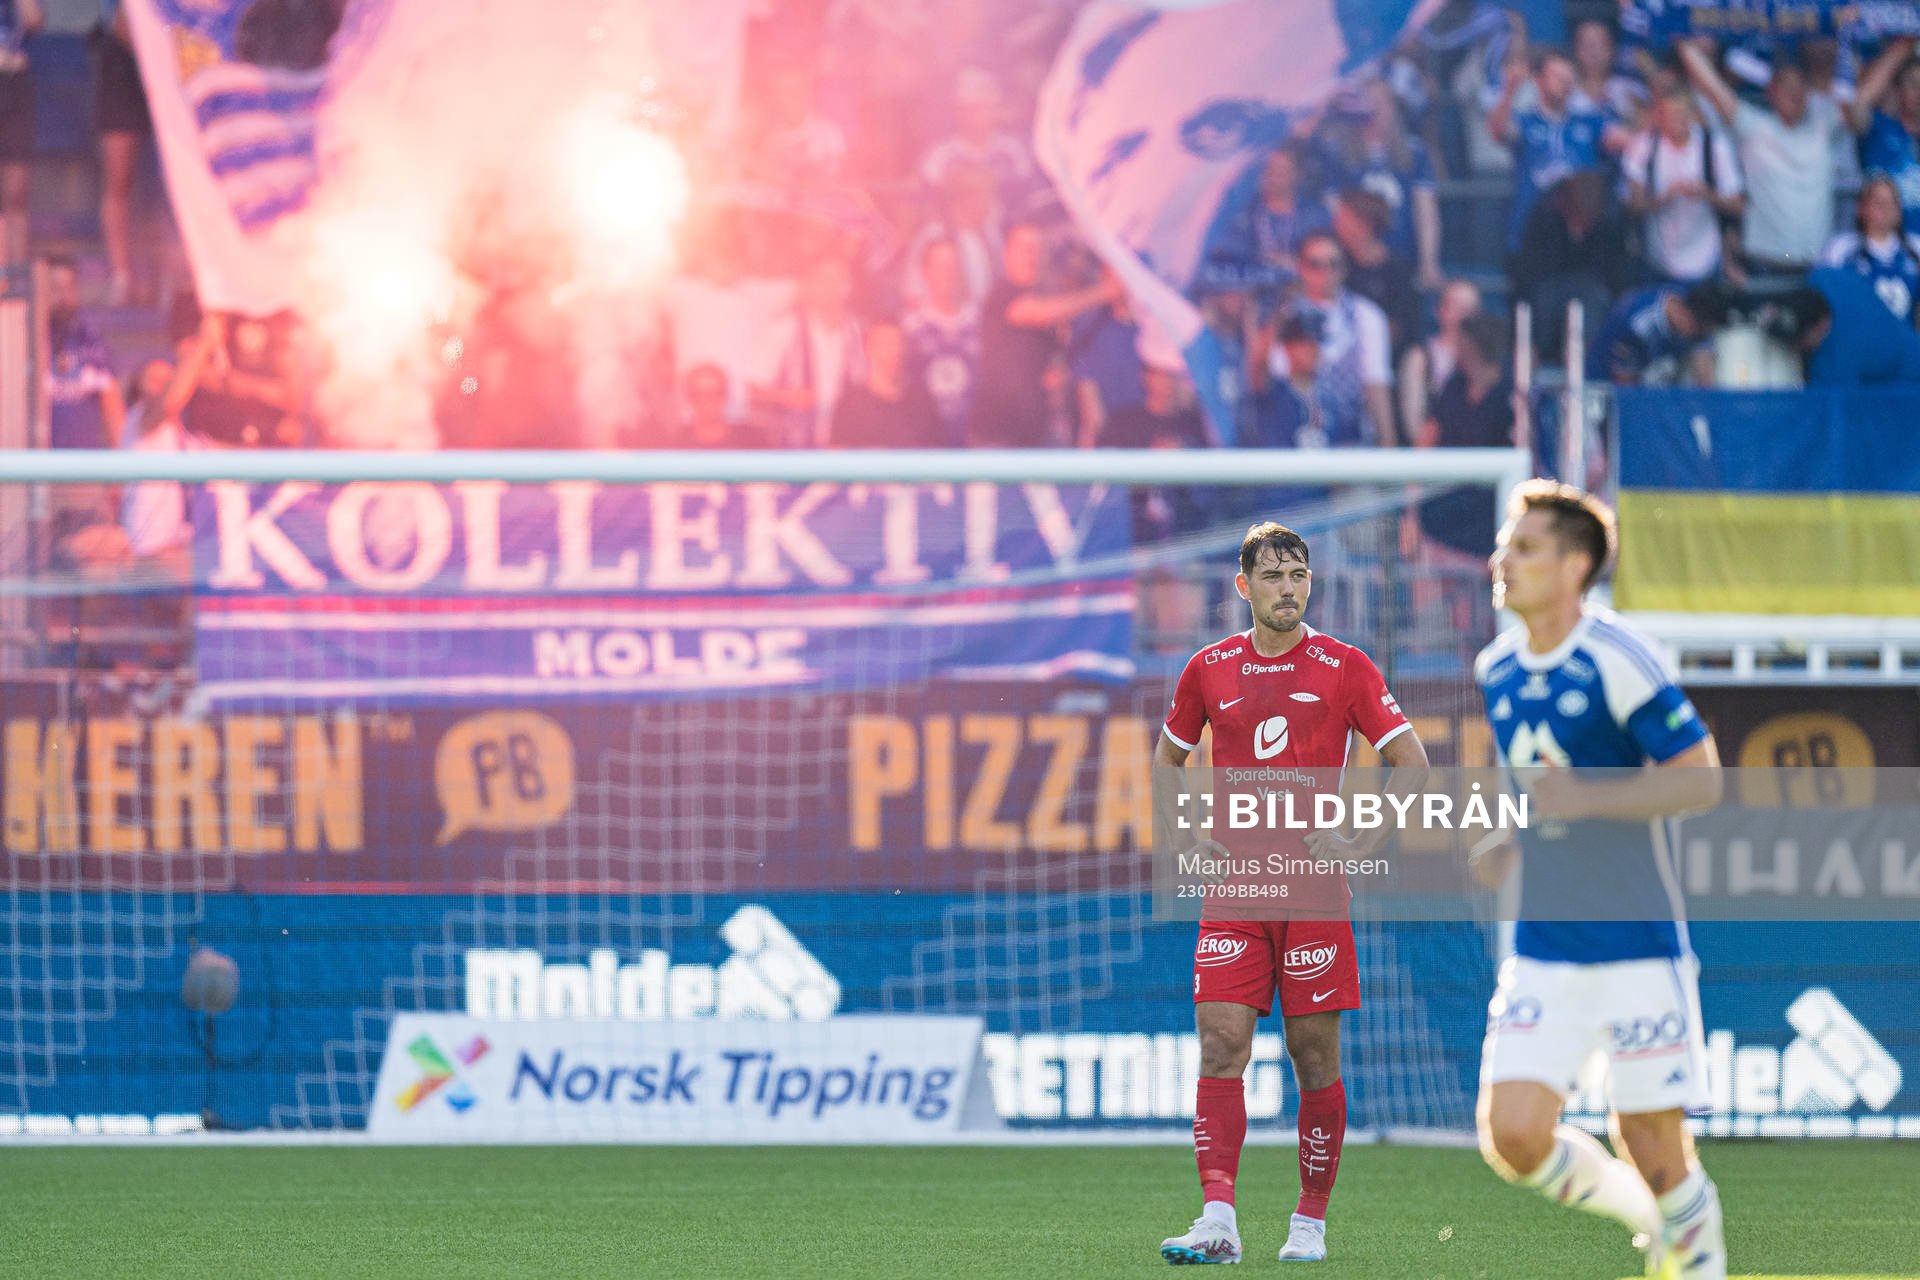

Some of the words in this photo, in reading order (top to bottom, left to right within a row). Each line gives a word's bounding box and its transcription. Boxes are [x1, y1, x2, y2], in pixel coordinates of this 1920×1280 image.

[206, 479, 1110, 592] KOLLEKTIV
[533, 626, 807, 682] MOLDE
[1220, 646, 1243, 661] BOB
[1318, 653, 1341, 669] BOB
[1252, 662, 1295, 675] Fjordkraft
[471, 732, 547, 810] PB
[1225, 766, 1316, 788] Sparebanken
[1198, 938, 1243, 954] LERØY
[1284, 945, 1336, 967] LERØY
[511, 1049, 699, 1104] Norsk
[721, 1050, 955, 1122] Tipping
